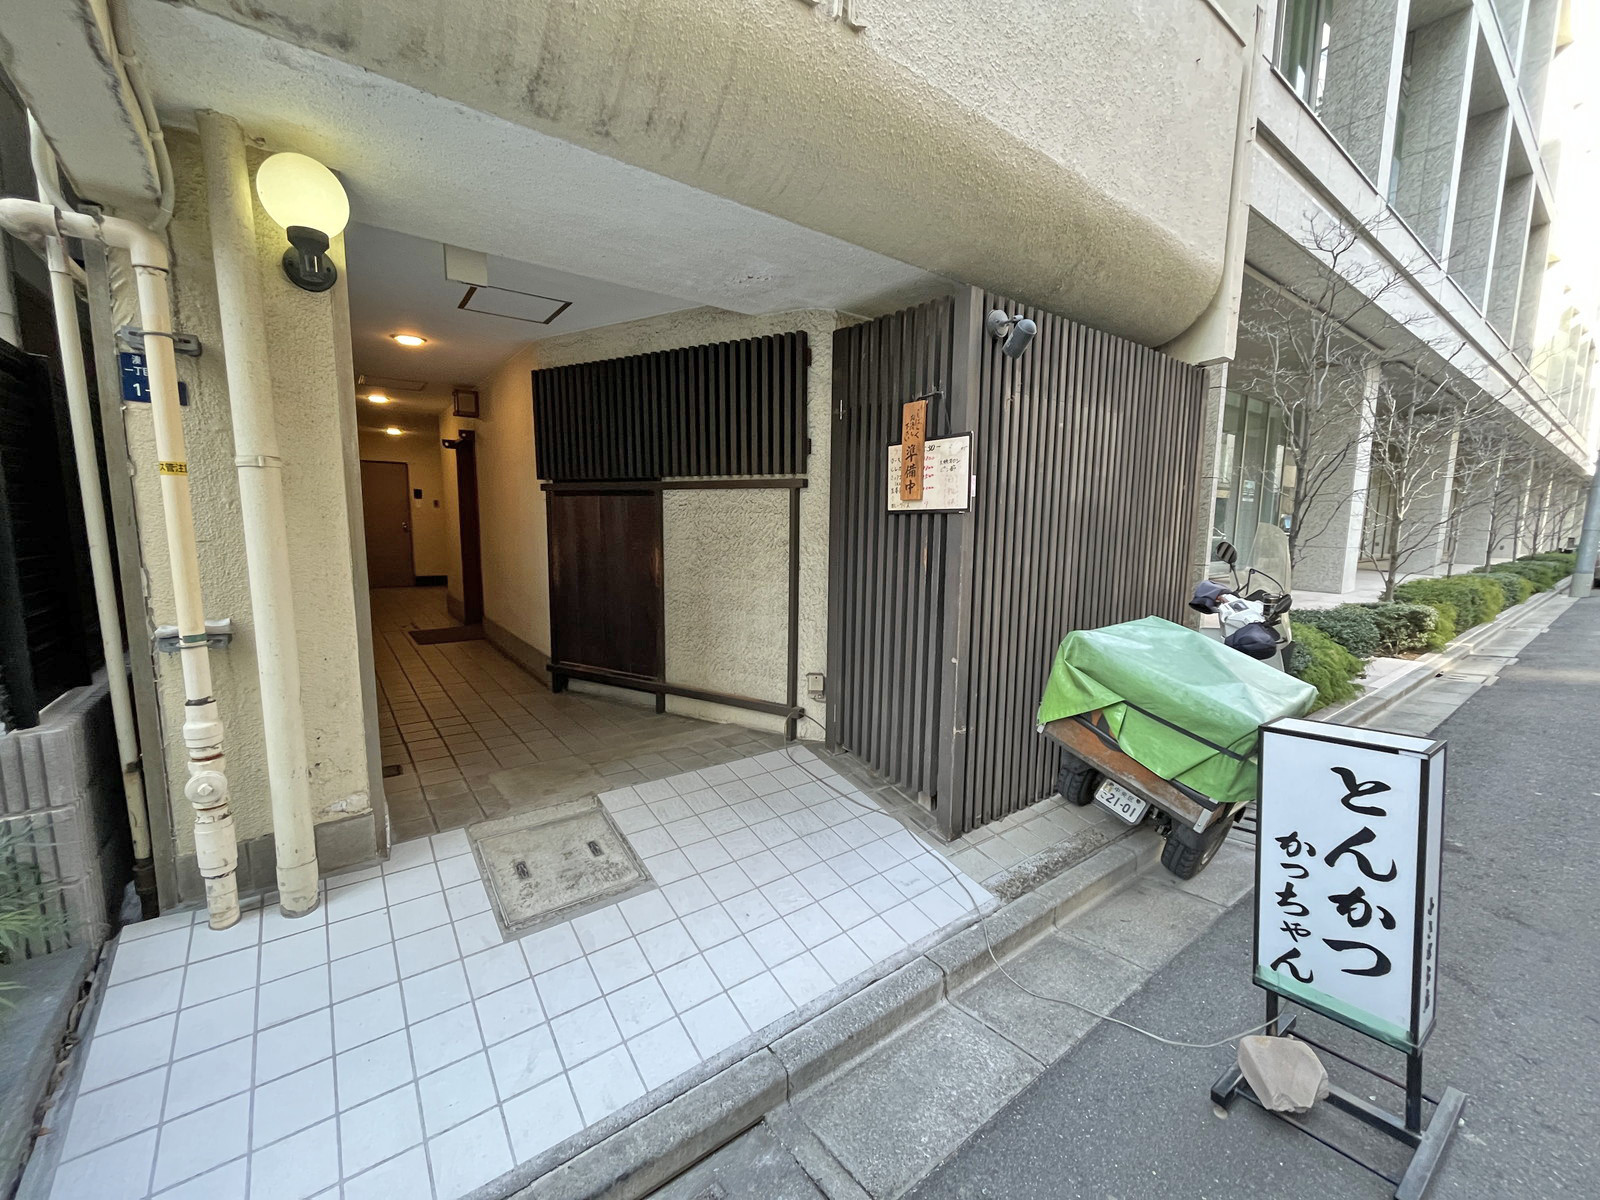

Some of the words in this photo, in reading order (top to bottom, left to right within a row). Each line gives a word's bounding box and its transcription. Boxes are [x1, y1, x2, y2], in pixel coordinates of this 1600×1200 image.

[905, 444, 918, 494] 準備中
[1105, 792, 1136, 817] 21-01
[1114, 787, 1134, 802] 中央区
[1322, 766, 1398, 977] とんかつ
